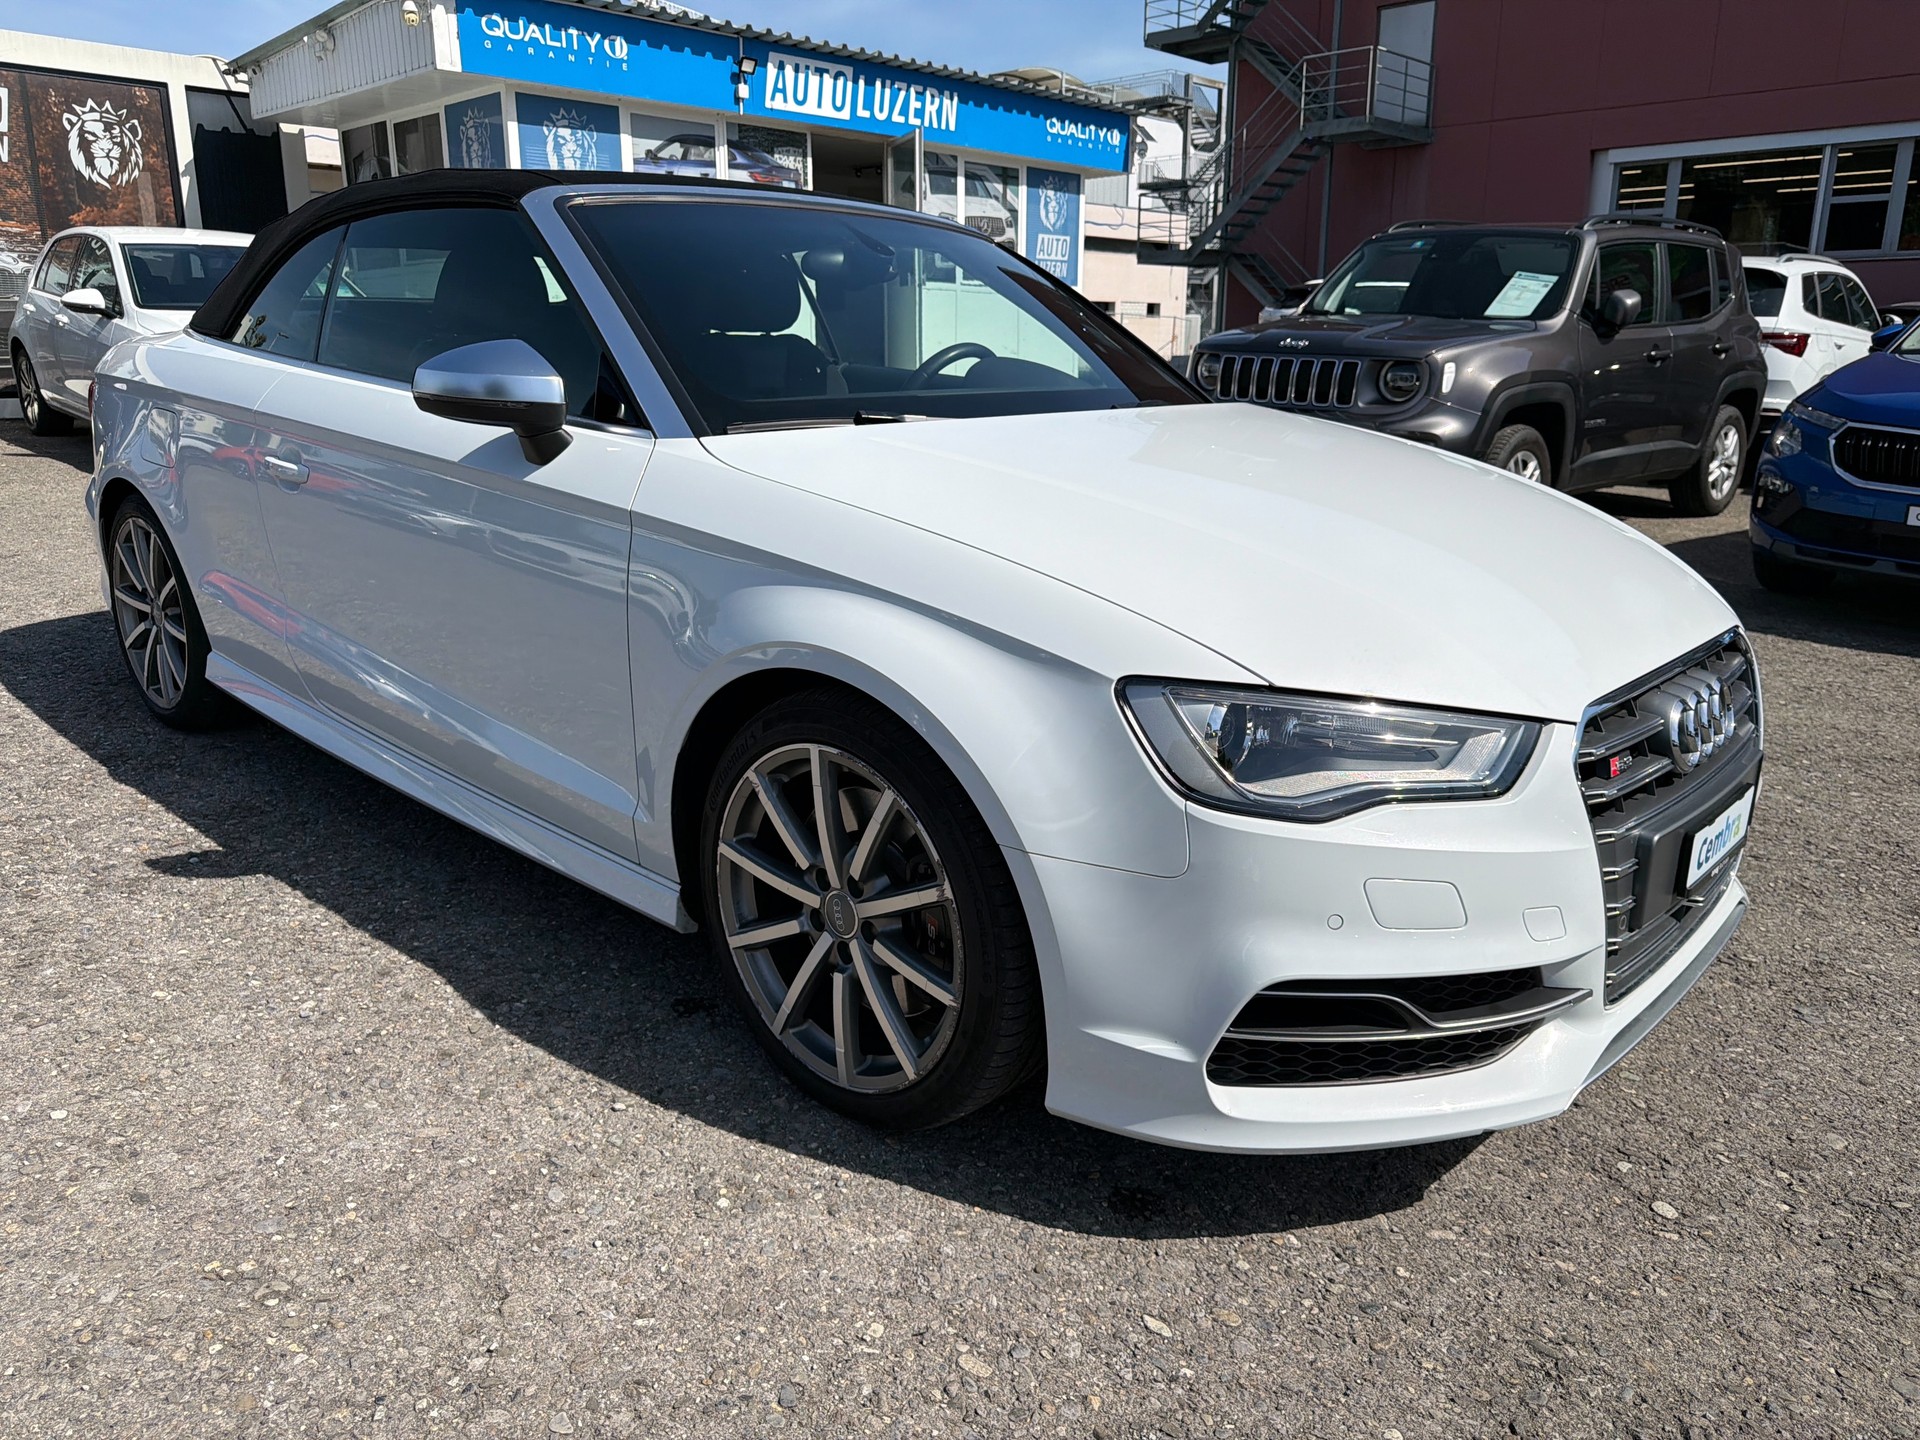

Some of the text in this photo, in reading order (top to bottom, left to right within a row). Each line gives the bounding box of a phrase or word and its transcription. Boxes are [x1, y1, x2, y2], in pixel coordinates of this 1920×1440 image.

[481, 14, 601, 54] QUALITY
[483, 39, 629, 71] GARANTIE
[769, 59, 959, 132] AUTO LUZERN
[1046, 117, 1107, 142] QUALITY
[1038, 236, 1068, 258] AUTO
[1035, 259, 1068, 278] ZERN
[1696, 813, 1742, 871] Cembra
